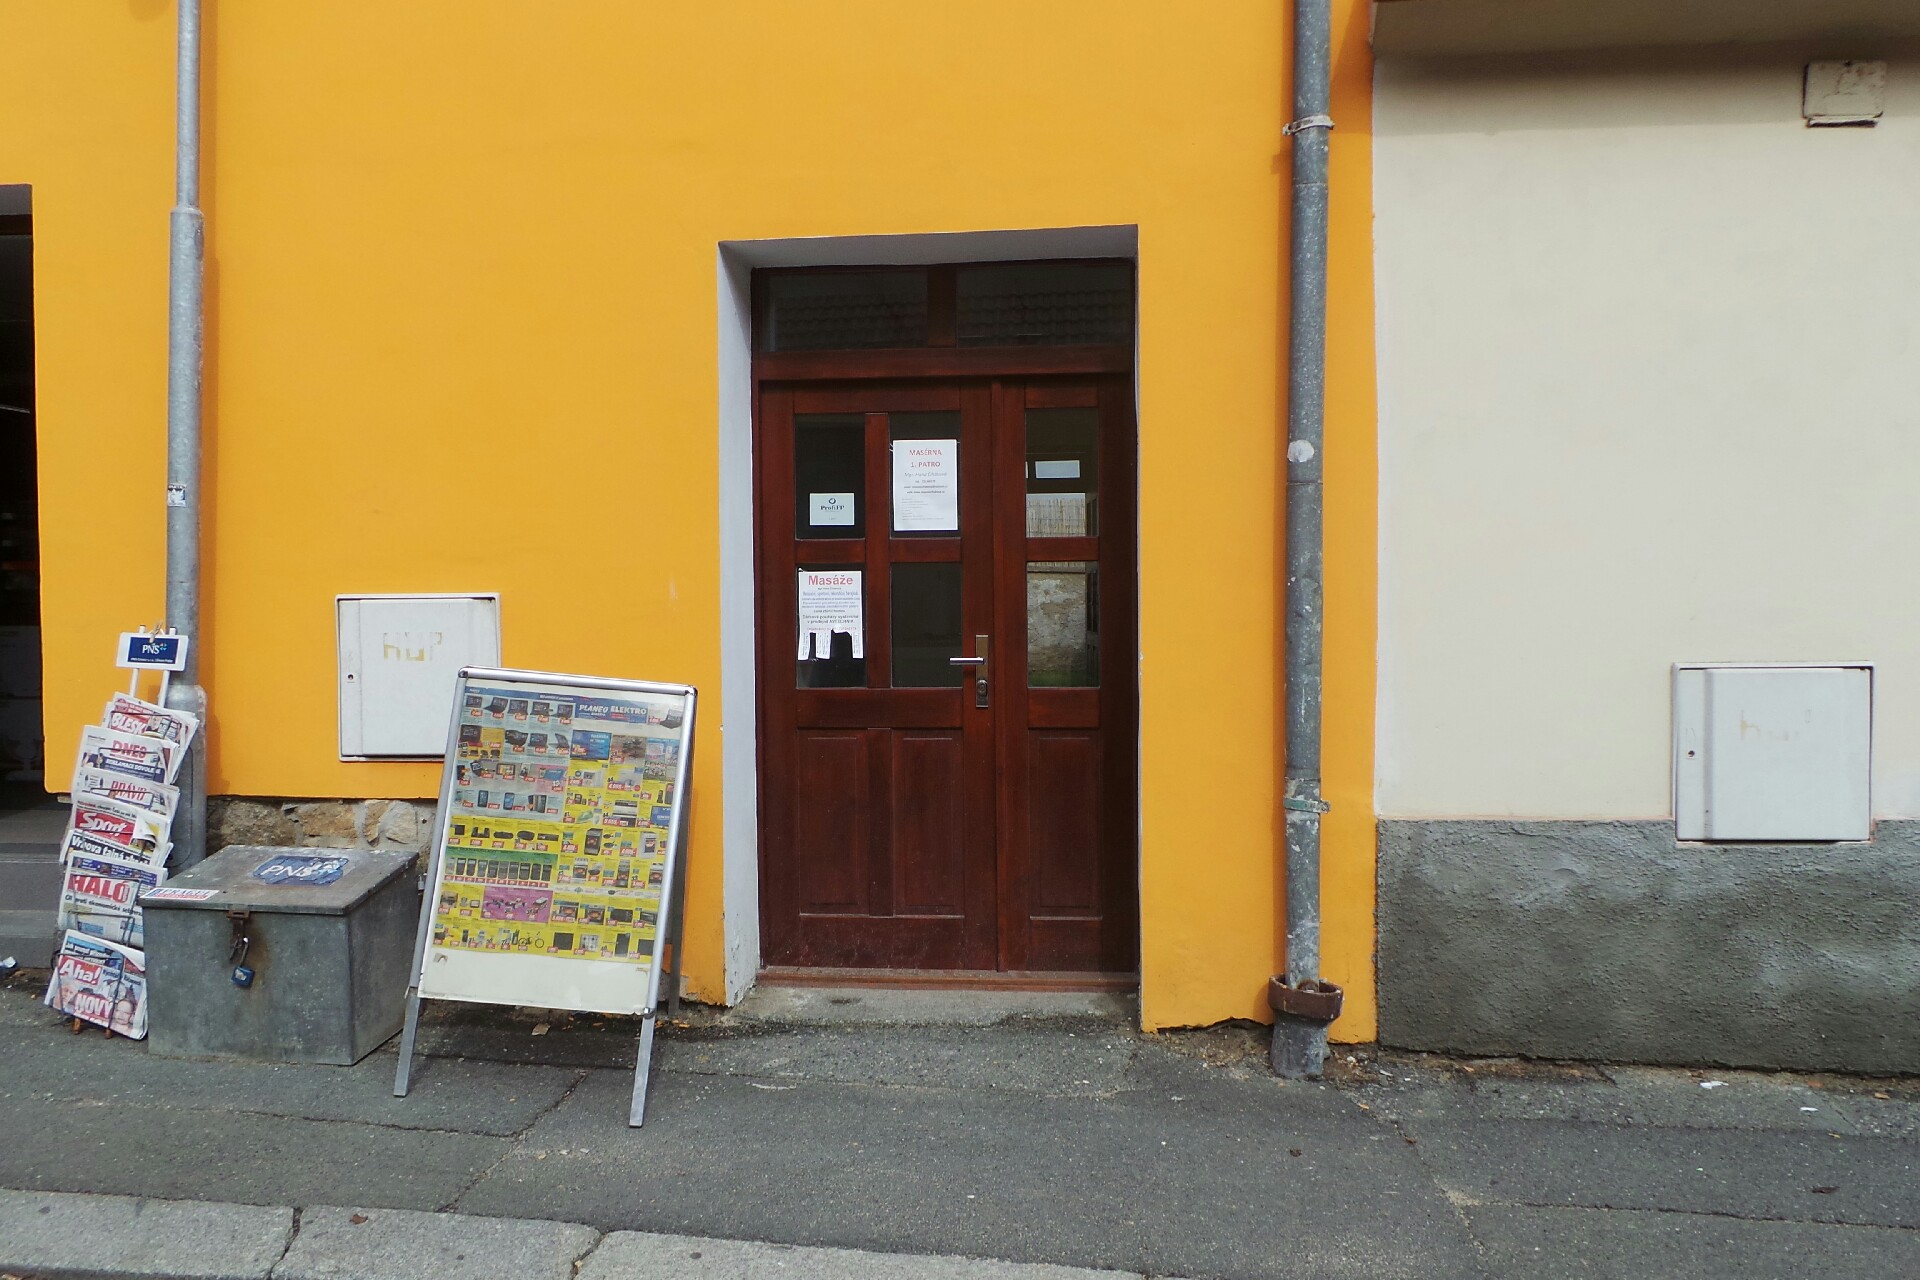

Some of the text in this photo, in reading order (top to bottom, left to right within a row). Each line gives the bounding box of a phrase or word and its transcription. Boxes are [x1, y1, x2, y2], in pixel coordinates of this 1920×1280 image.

[808, 574, 853, 585] Masáže
[142, 644, 160, 654] PNS
[579, 704, 647, 715] PLANEO ELEKTRO
[112, 714, 146, 734] BLESK
[112, 740, 147, 758] DNES
[111, 780, 147, 801] PRÁVO
[260, 864, 311, 878] PNS
[68, 874, 130, 903] HALÓ
[60, 959, 101, 985] Aha!
